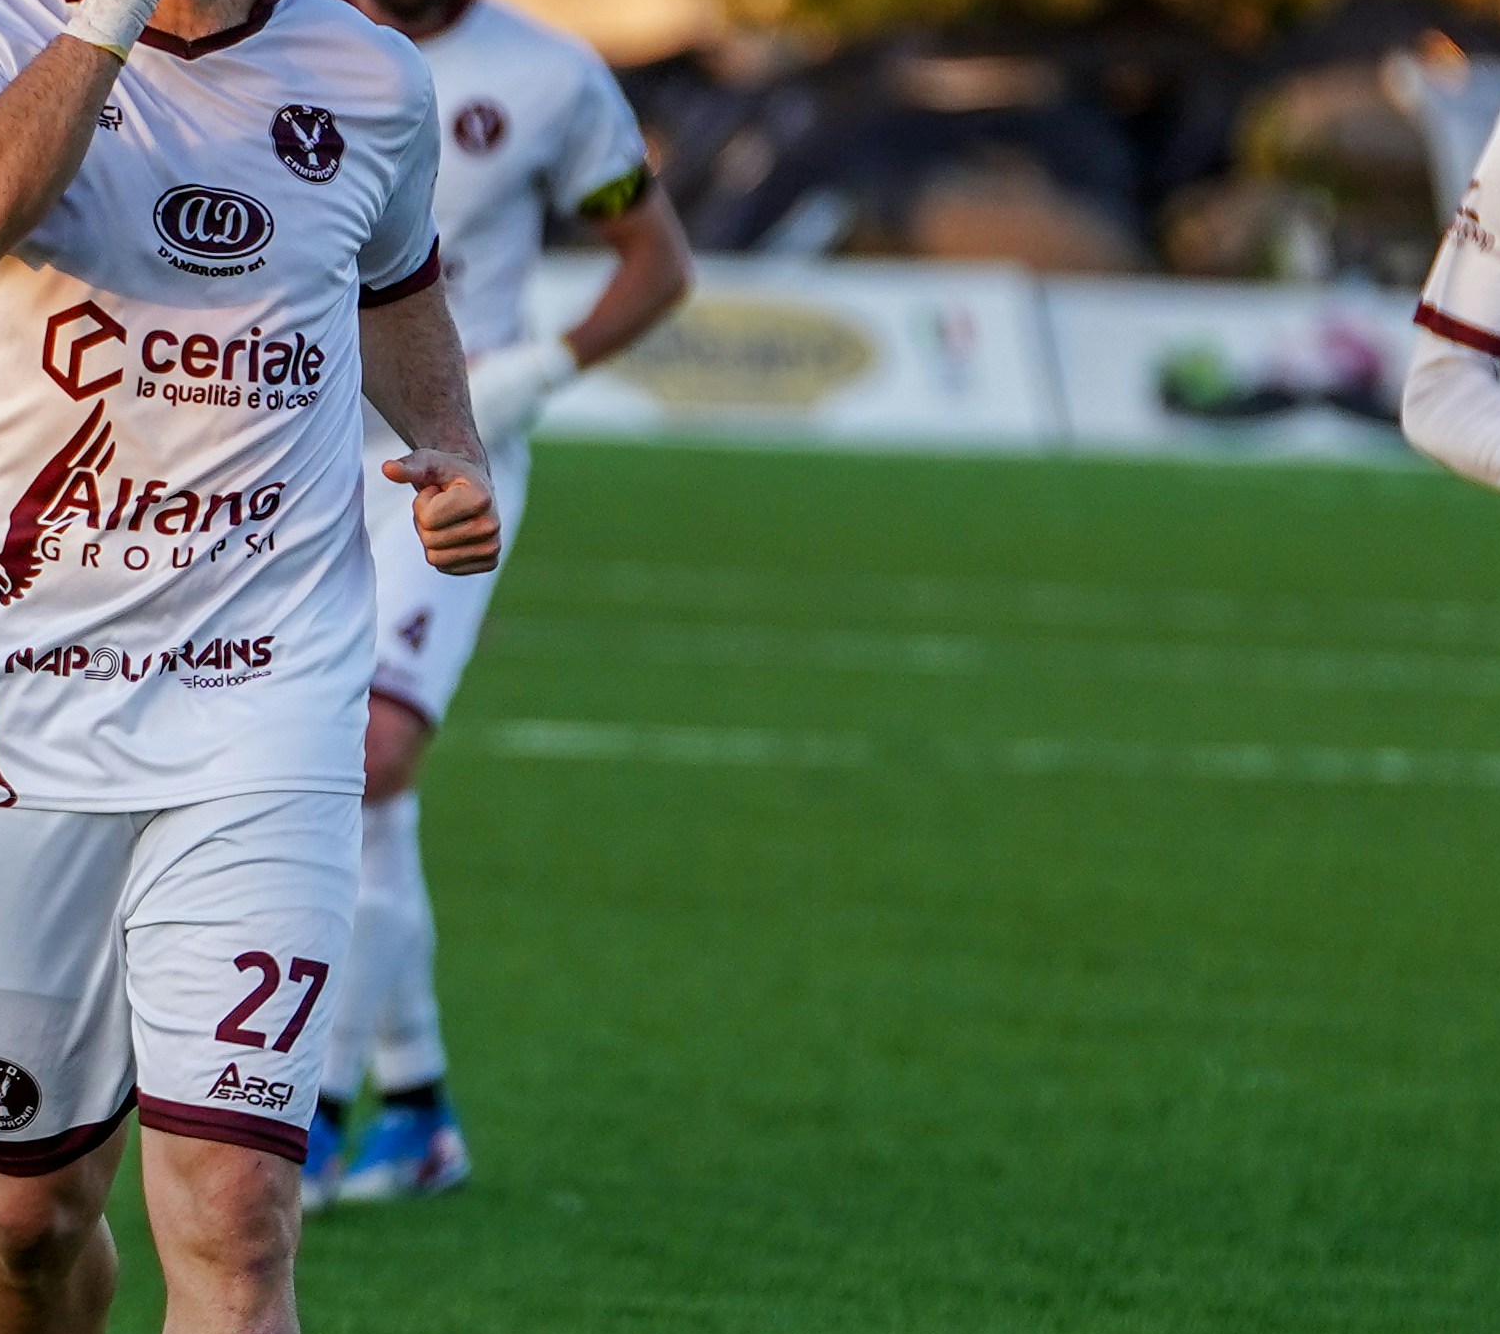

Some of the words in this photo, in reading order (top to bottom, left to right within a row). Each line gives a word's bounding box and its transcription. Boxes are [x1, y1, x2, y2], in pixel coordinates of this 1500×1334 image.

[284, 155, 339, 180] CAMPAGNA
[157, 245, 245, 277] D'AMBROSIO
[141, 326, 325, 386] ceriale
[136, 375, 156, 398] la
[162, 383, 241, 407] qualità
[247, 387, 261, 409] è
[286, 390, 319, 409] cas
[43, 470, 286, 536] Alfano
[40, 535, 227, 571] GROUP
[193, 673, 224, 689] Food
[214, 950, 330, 1054] 27
[206, 1061, 295, 1102] ARCI
[212, 1088, 290, 1112] SPORT
